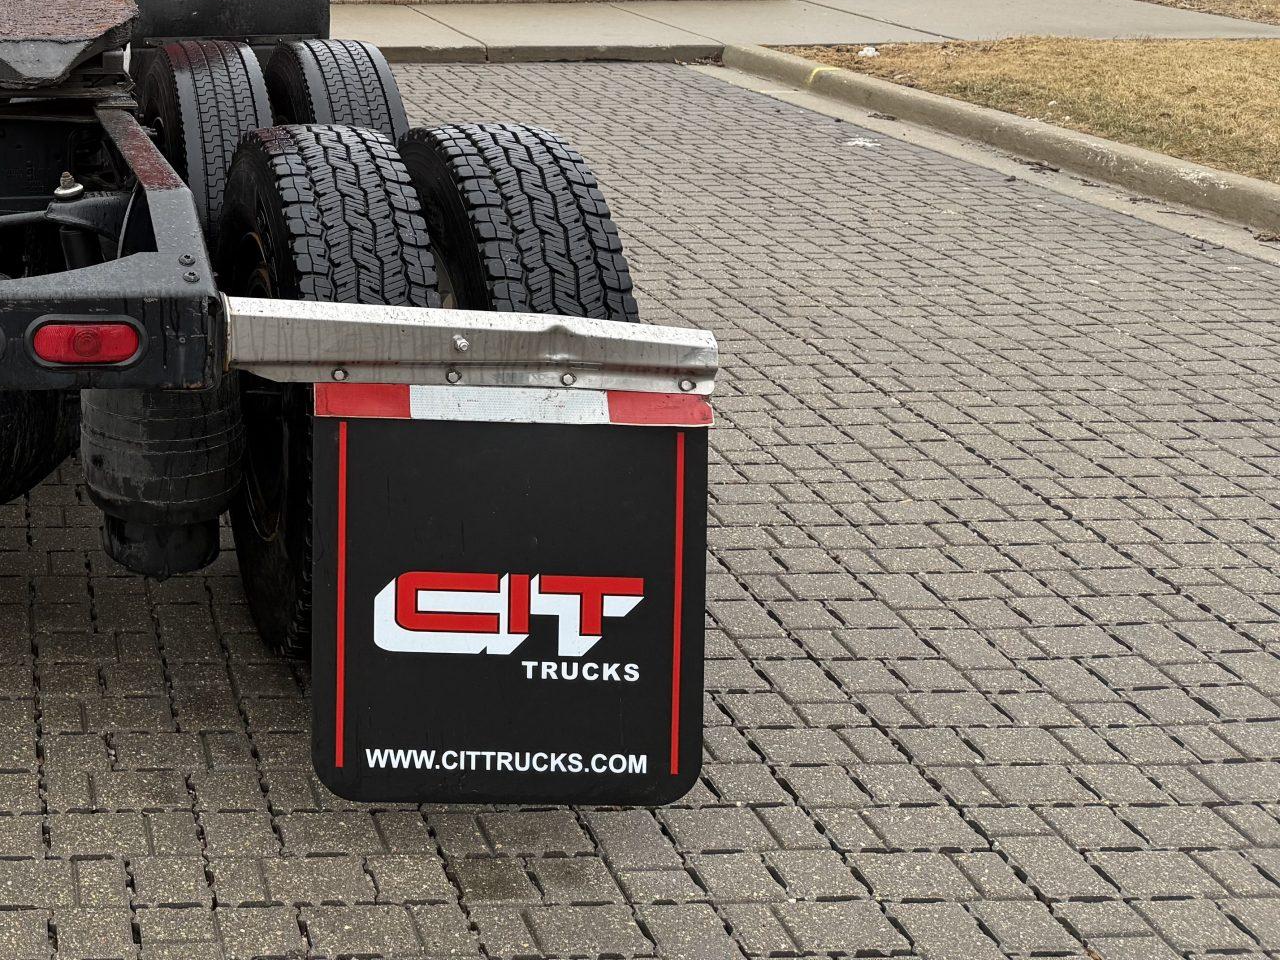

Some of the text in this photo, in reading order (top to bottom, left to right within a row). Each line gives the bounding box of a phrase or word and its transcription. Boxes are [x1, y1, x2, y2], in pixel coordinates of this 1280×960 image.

[374, 571, 645, 657] CIT
[521, 660, 641, 682] TRUCKS
[365, 748, 648, 775] WWW.CITTRUCKS.COM
